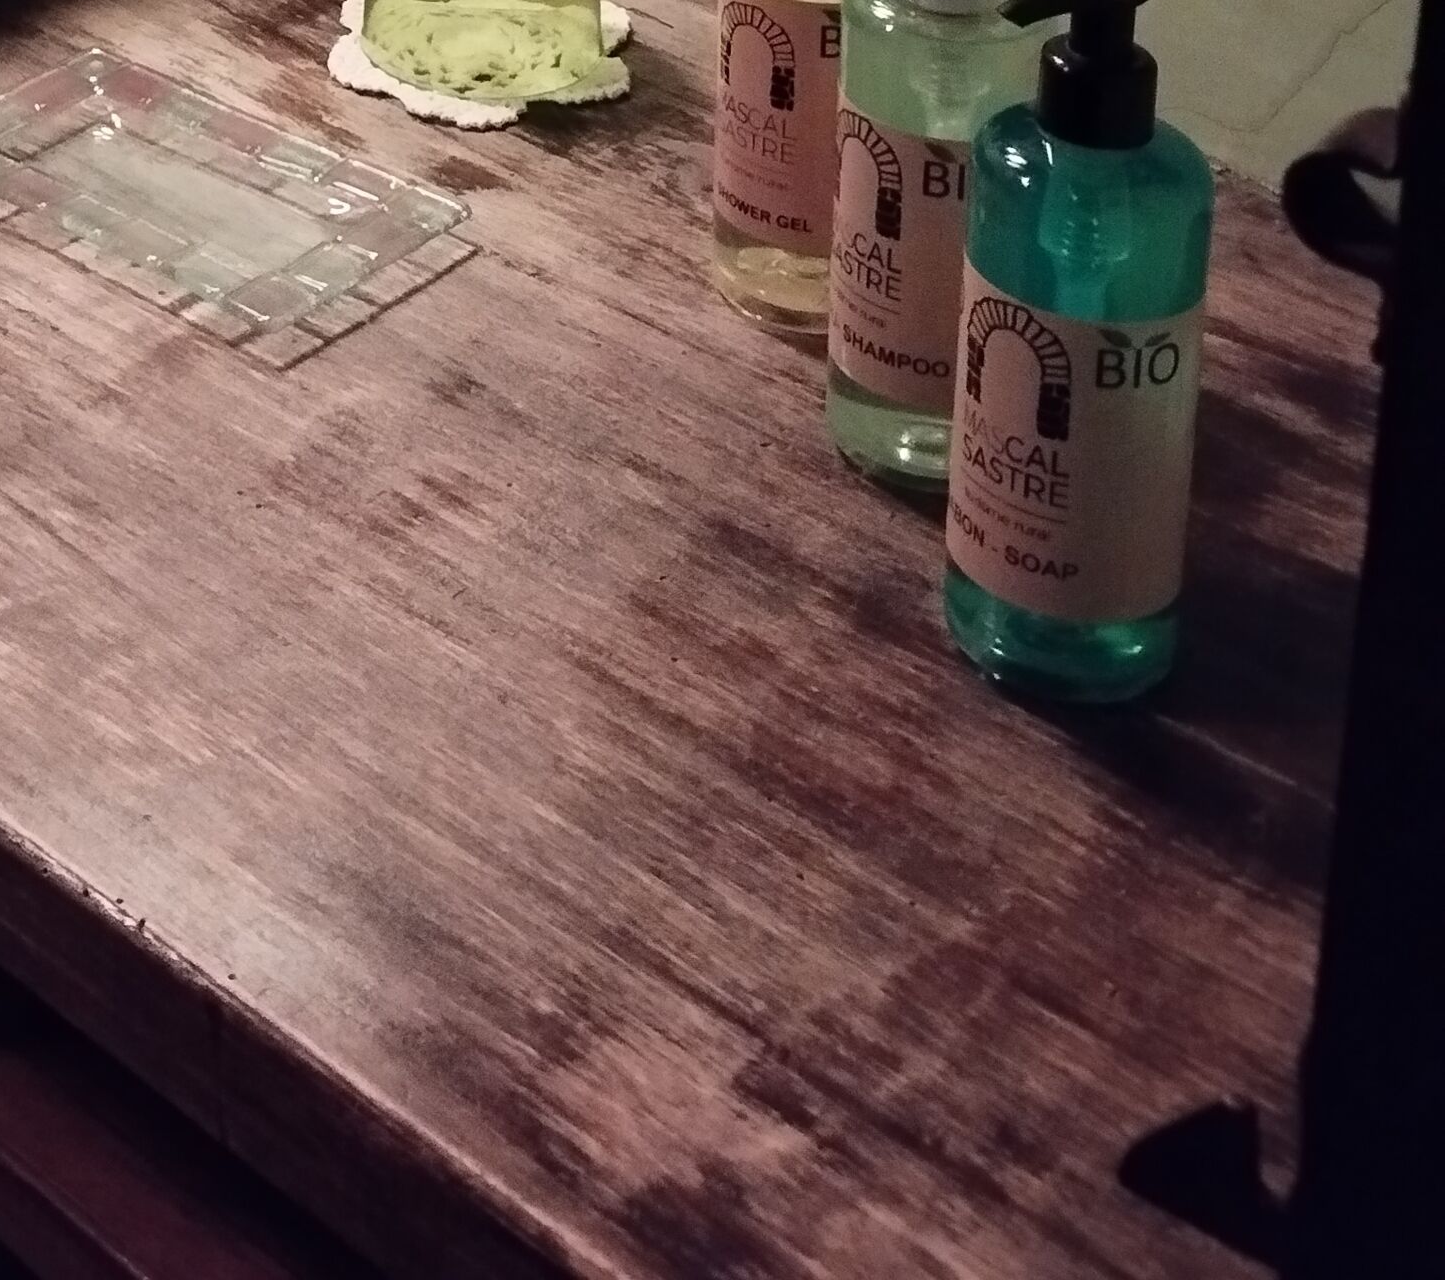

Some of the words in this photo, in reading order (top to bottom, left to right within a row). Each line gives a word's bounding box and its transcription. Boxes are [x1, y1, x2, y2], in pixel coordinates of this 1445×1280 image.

[722, 119, 795, 165] ASTRE
[923, 161, 966, 200] BI
[776, 214, 812, 233] GEL
[843, 323, 950, 378] SHAMPOO
[1095, 343, 1179, 389] BIO
[964, 401, 1070, 480] MASCAL
[962, 433, 1069, 510] SASTRE
[1004, 544, 1079, 580] SOAP
